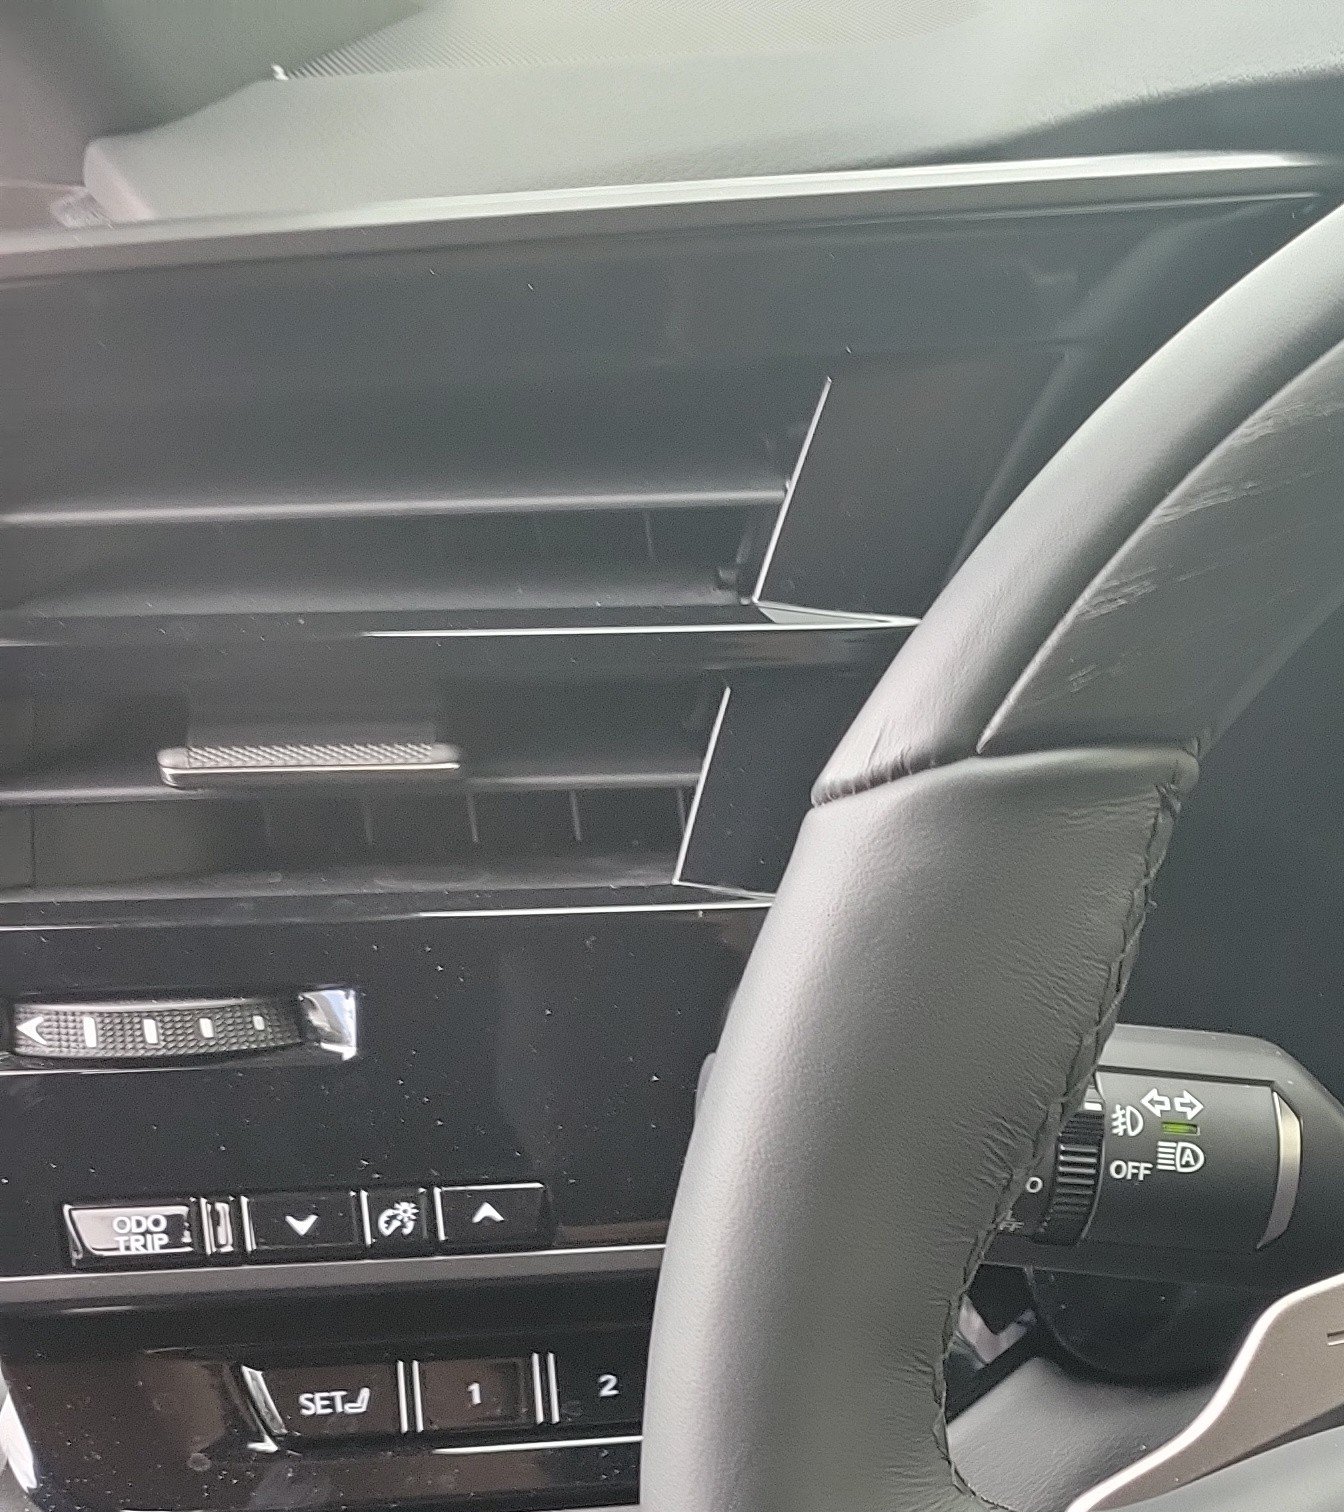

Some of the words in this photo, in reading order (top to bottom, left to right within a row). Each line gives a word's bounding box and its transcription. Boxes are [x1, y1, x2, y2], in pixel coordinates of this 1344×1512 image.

[1109, 1160, 1153, 1182] OFF
[112, 1215, 167, 1234] ODO
[114, 1233, 169, 1252] TRIP
[467, 1382, 482, 1405] 1
[599, 1374, 619, 1397] 2
[299, 1391, 347, 1416] SET
